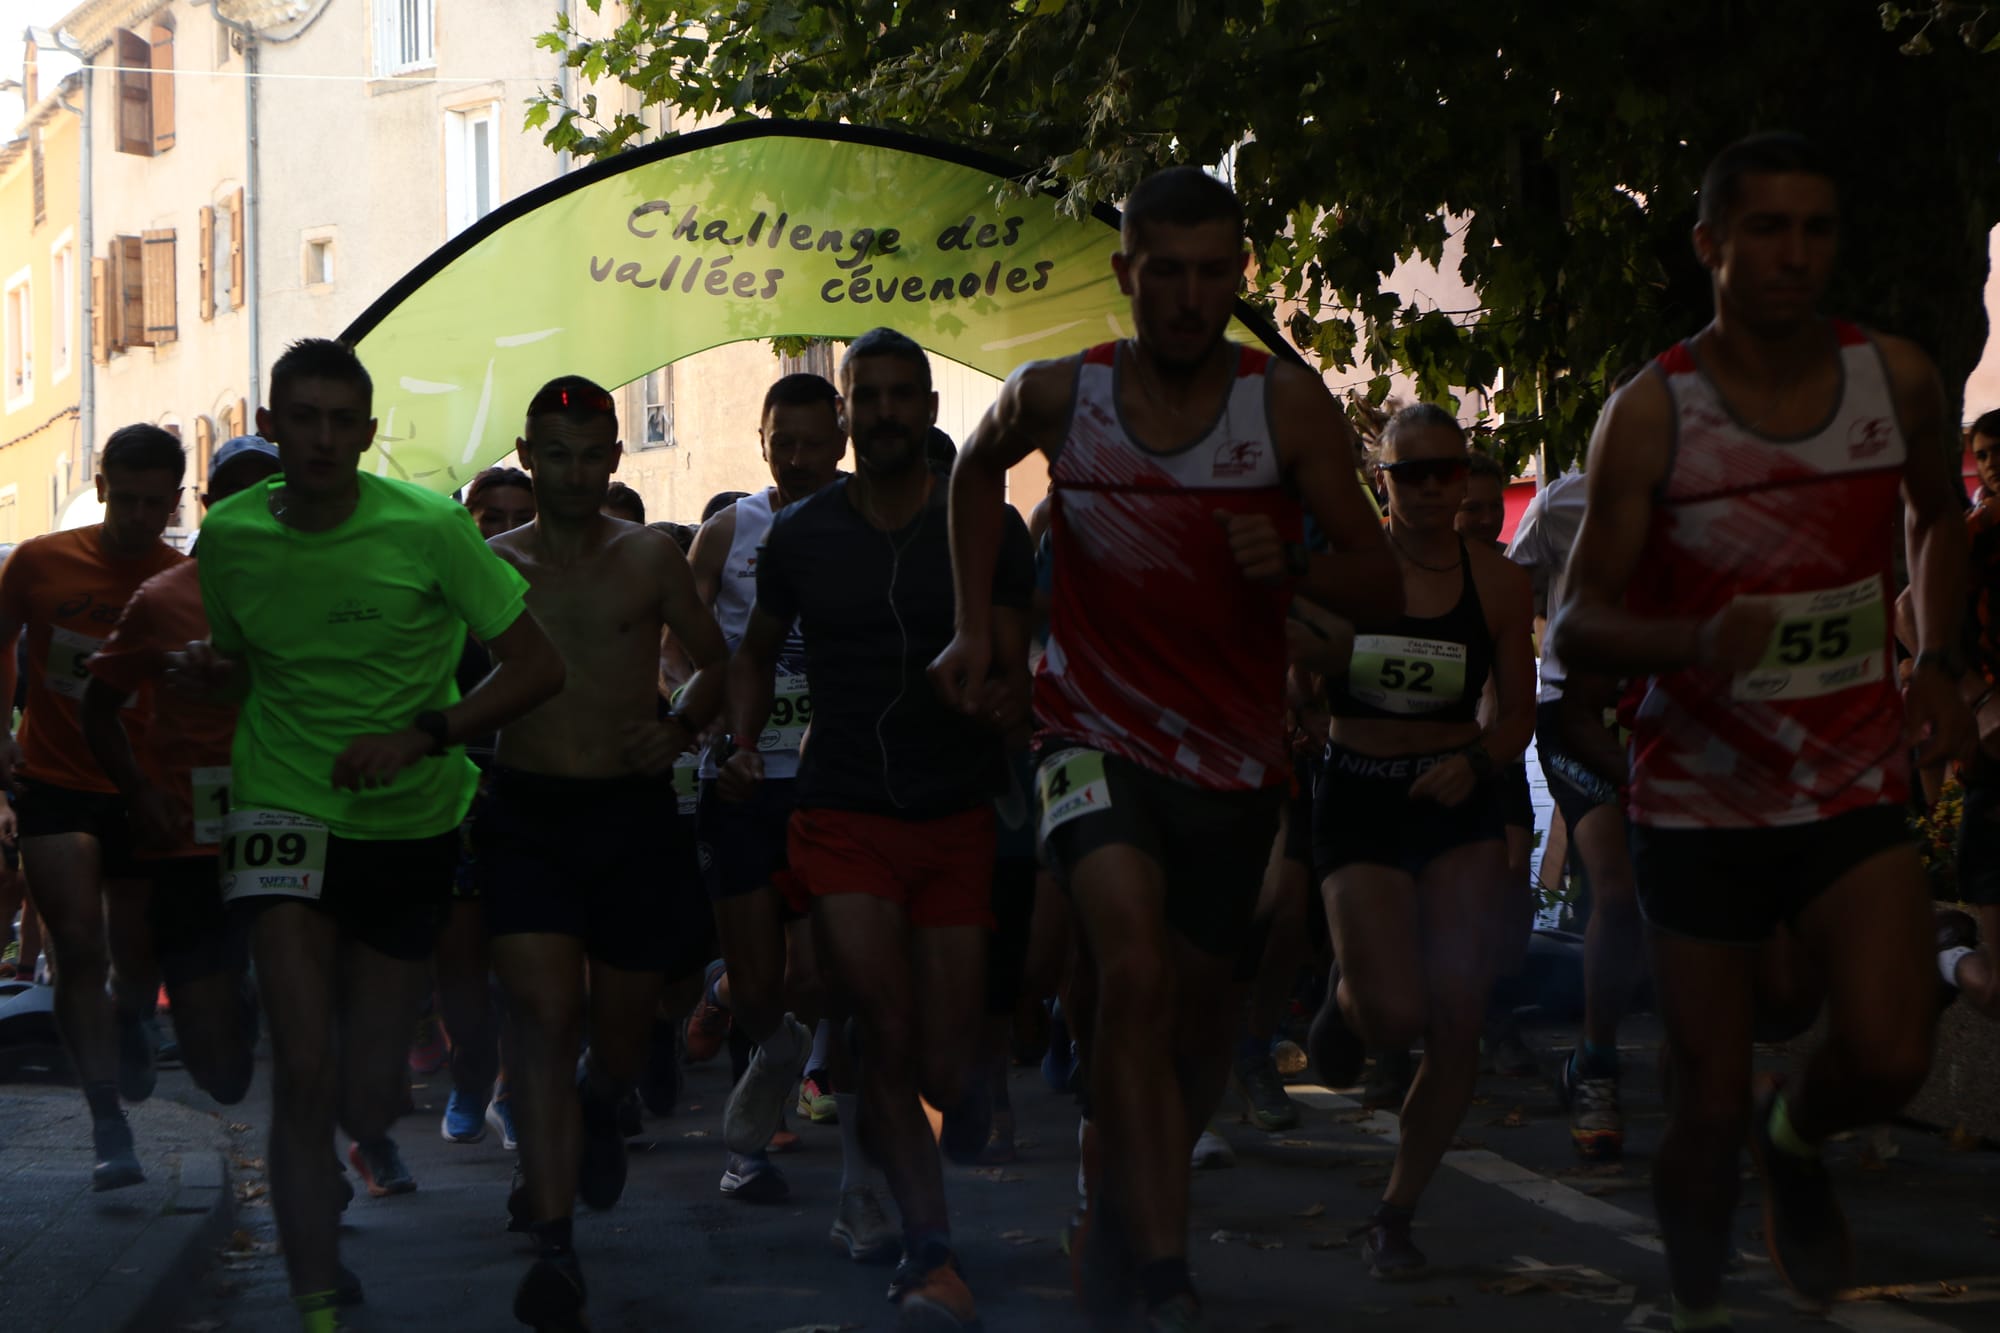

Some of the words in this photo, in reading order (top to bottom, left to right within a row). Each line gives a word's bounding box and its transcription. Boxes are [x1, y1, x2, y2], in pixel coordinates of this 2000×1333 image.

[627, 200, 901, 269] Challenge
[936, 214, 1024, 252] des
[589, 254, 785, 300] vallées
[820, 259, 1055, 304] cévenoles
[1779, 616, 1850, 665] 55
[1379, 658, 1435, 693] 52
[772, 695, 814, 726] 99
[1049, 765, 1071, 798] 4
[1338, 752, 1411, 779] NIKE
[225, 832, 307, 871] 109
